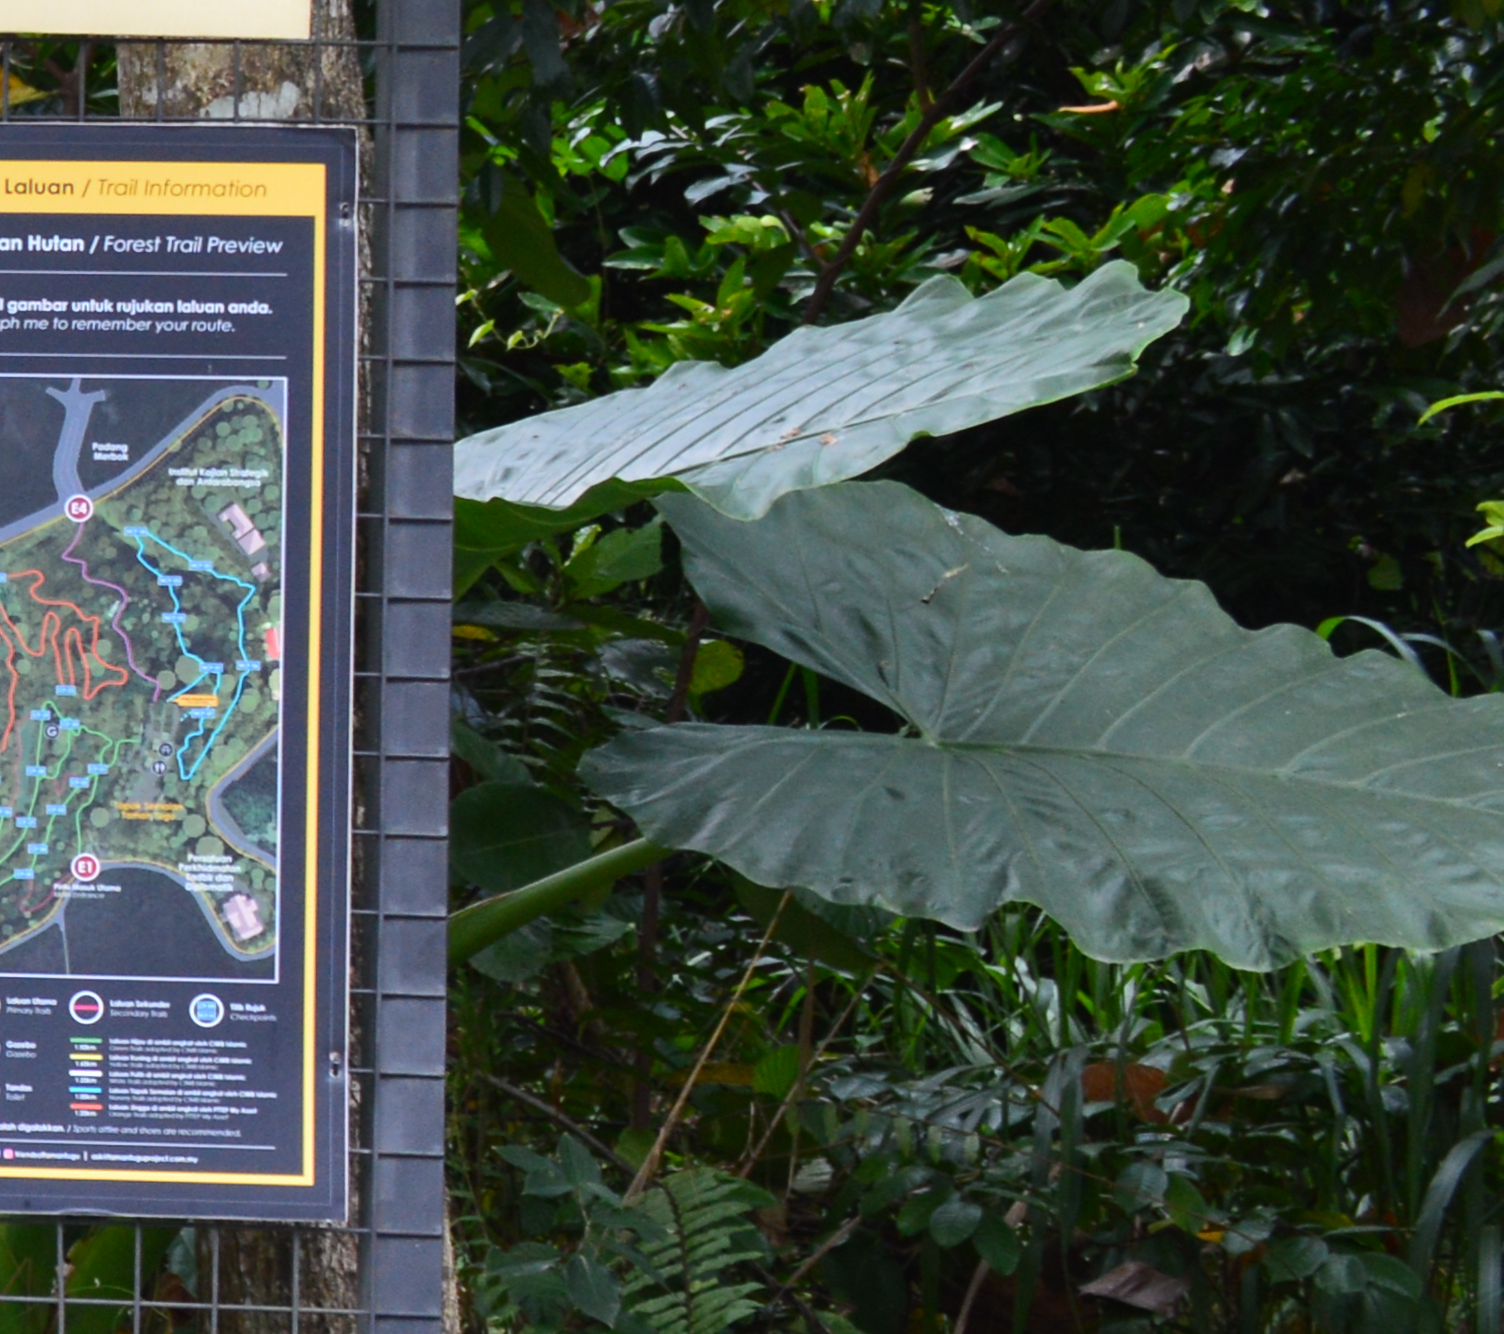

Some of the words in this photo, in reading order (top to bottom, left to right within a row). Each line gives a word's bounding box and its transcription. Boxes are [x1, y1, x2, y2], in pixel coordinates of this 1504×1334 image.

[5, 178, 73, 194] Laluan
[82, 179, 90, 197] /
[100, 179, 137, 195] Trail
[145, 182, 265, 196] Information
[28, 235, 84, 251] Hutan
[89, 235, 99, 254] /
[104, 235, 160, 252] Forest
[167, 236, 202, 252] Trail
[207, 237, 282, 253] Preview
[7, 298, 68, 314] gambar
[71, 299, 113, 312] untuk
[116, 299, 173, 315] rujukan
[177, 299, 224, 313] laluan
[227, 300, 272, 313] anda.
[23, 319, 48, 329] me
[53, 317, 68, 330] to
[71, 318, 151, 330] remember
[155, 320, 188, 333] your
[191, 319, 234, 331] route.
[92, 443, 128, 452] Padang
[94, 453, 128, 461] Merbok
[71, 503, 87, 514] E4
[47, 727, 57, 736] G
[78, 862, 92, 873] E1
